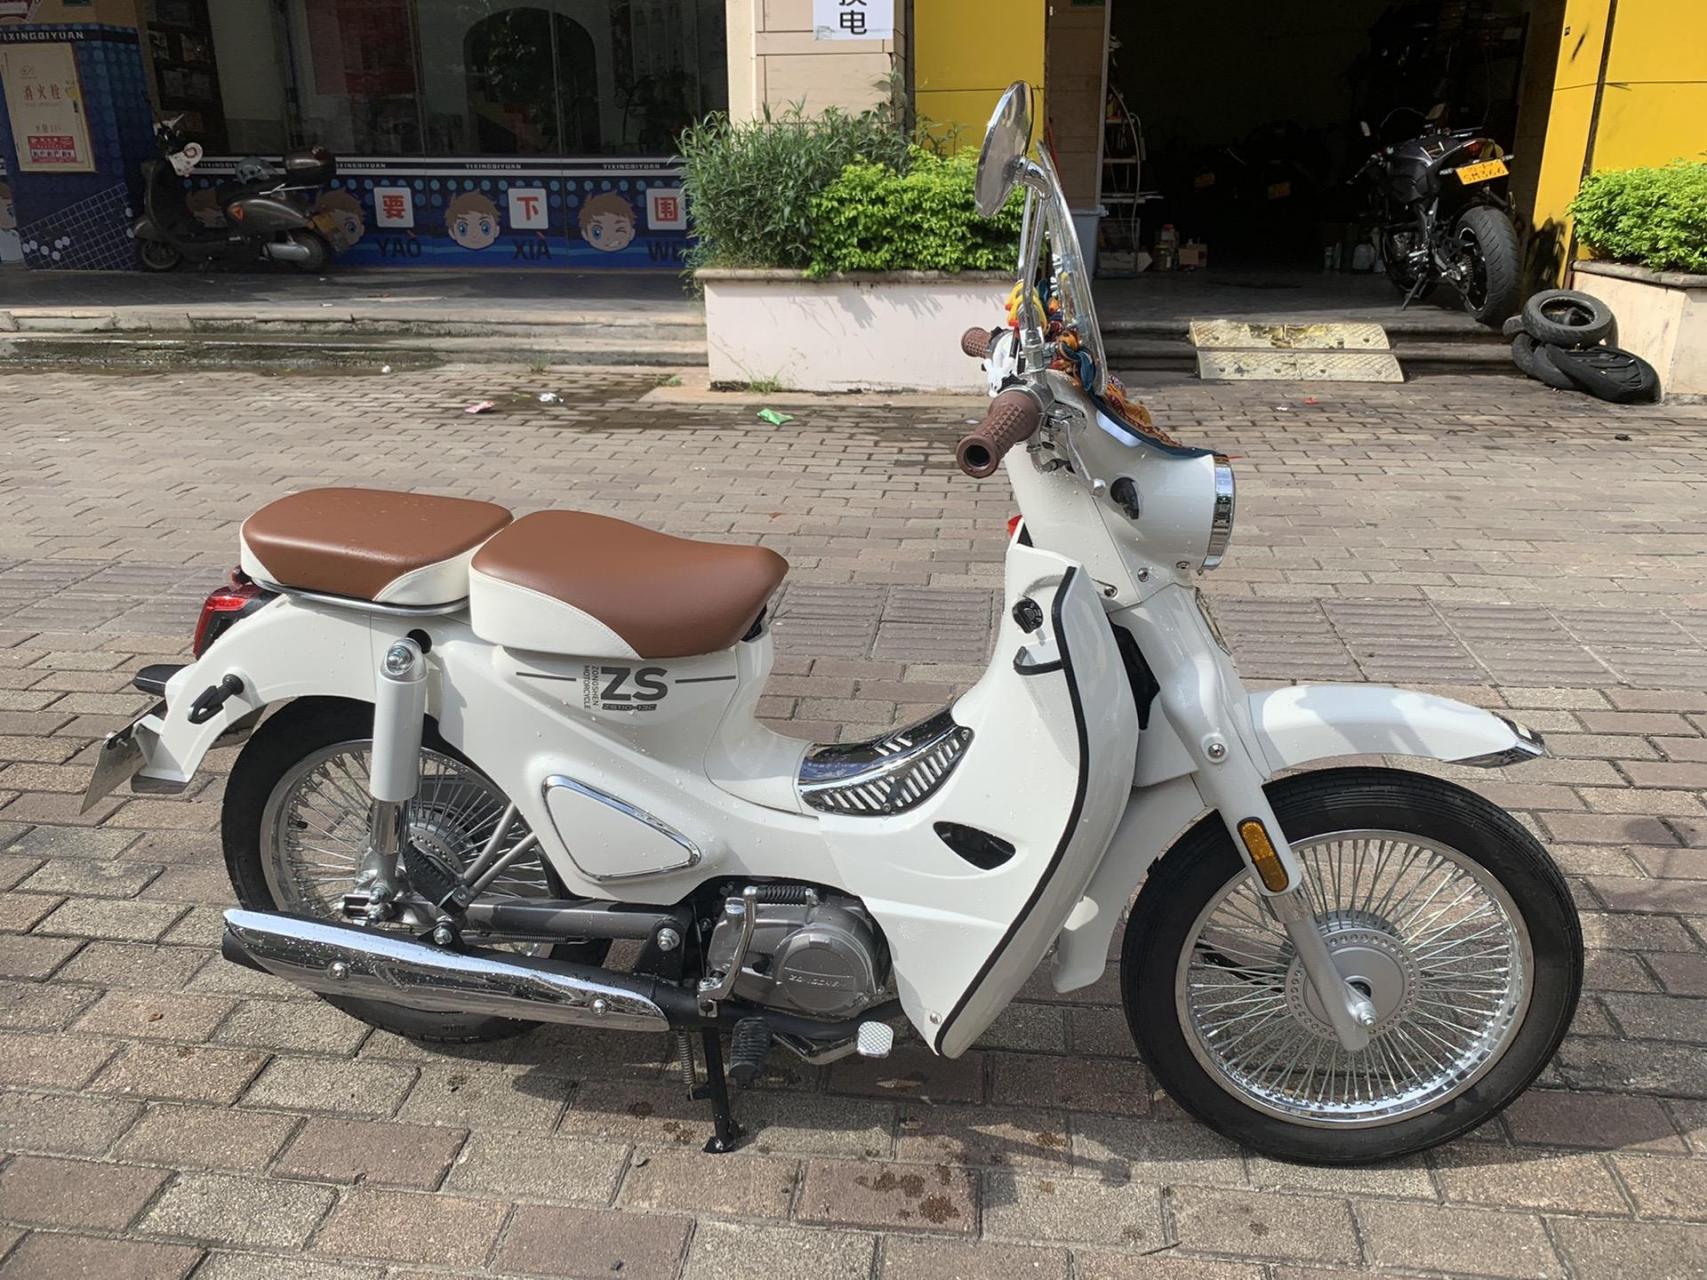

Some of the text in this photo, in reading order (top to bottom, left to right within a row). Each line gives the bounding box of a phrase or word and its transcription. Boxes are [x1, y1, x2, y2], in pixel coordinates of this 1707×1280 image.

[0, 31, 85, 41] IXINGQIYUAN
[382, 195, 678, 222] 要 下 围
[583, 665, 591, 710] MOTORCYCLE
[591, 665, 600, 706] ZONGSHEN
[600, 666, 669, 701] ZS
